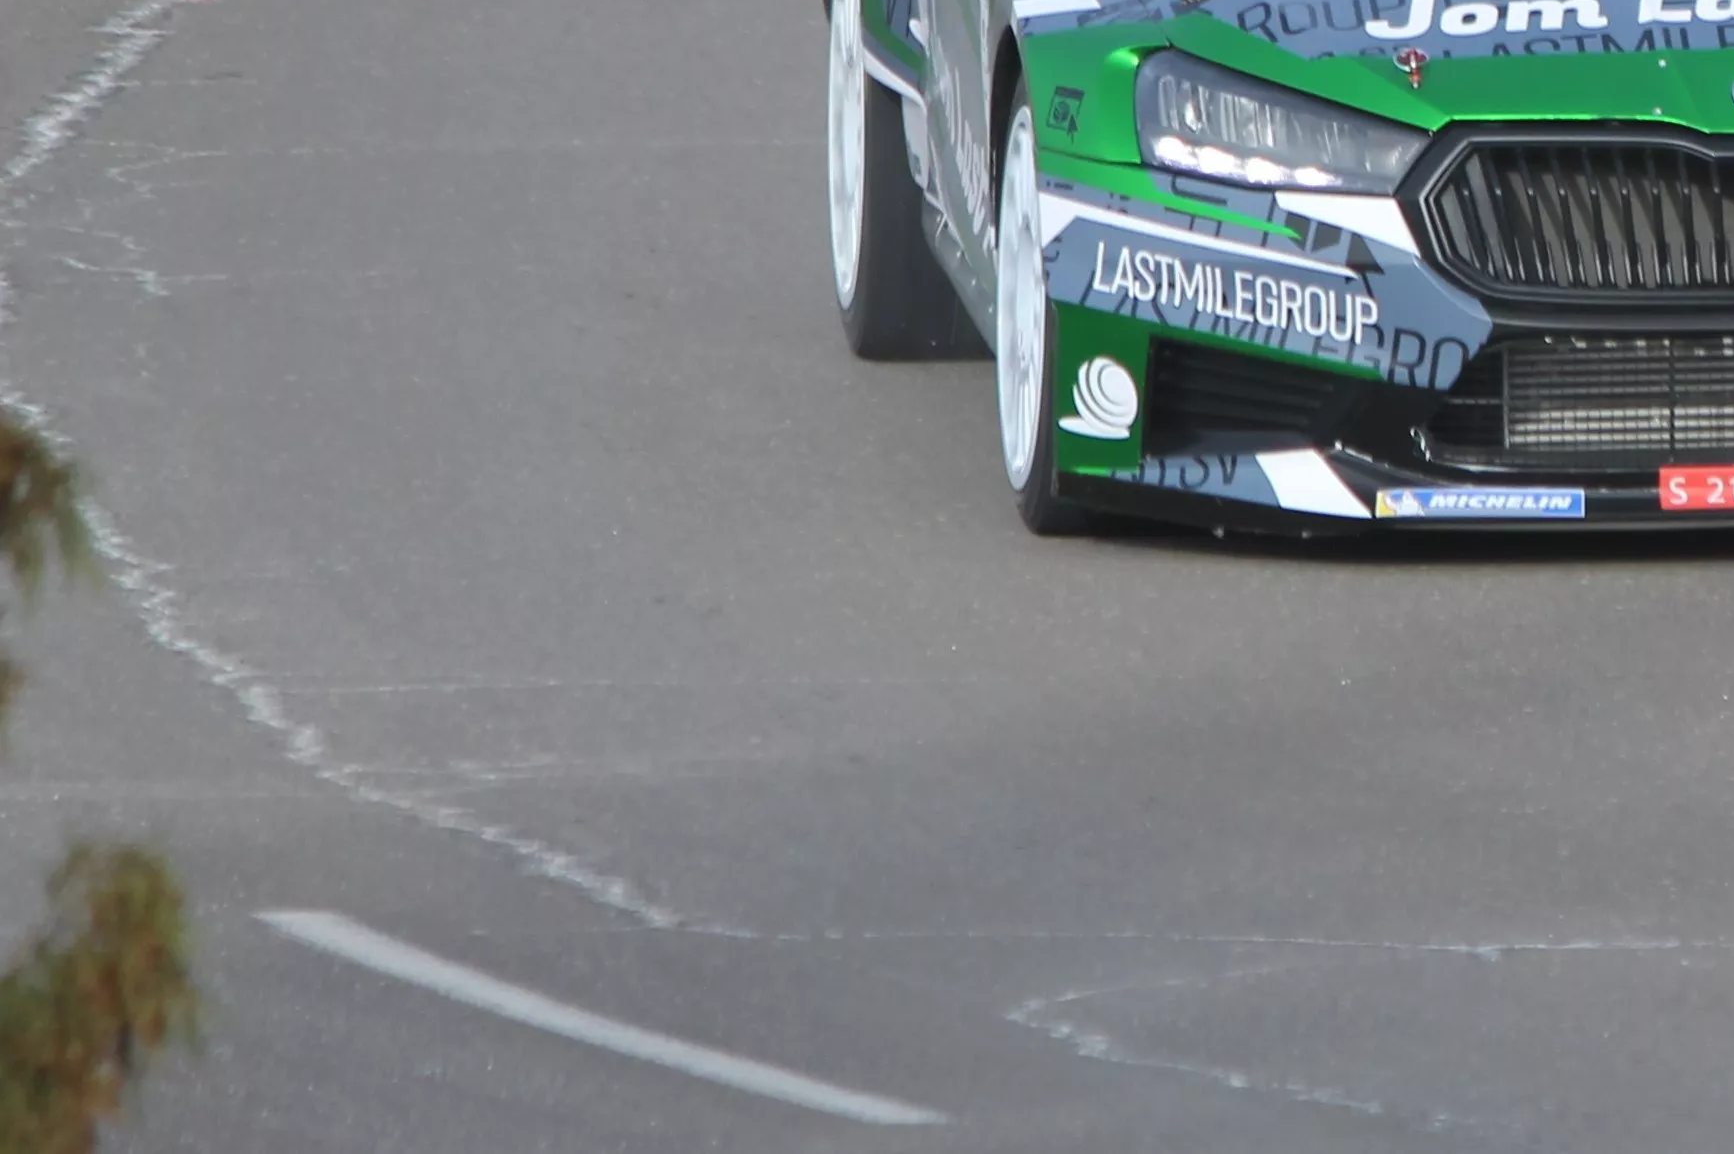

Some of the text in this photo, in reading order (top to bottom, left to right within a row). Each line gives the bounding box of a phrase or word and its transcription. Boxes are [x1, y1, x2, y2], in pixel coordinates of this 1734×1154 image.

[1092, 241, 1379, 344] LASTMILEGROUP
[1429, 493, 1573, 511] MICHELIN
[1669, 478, 1688, 505] S
